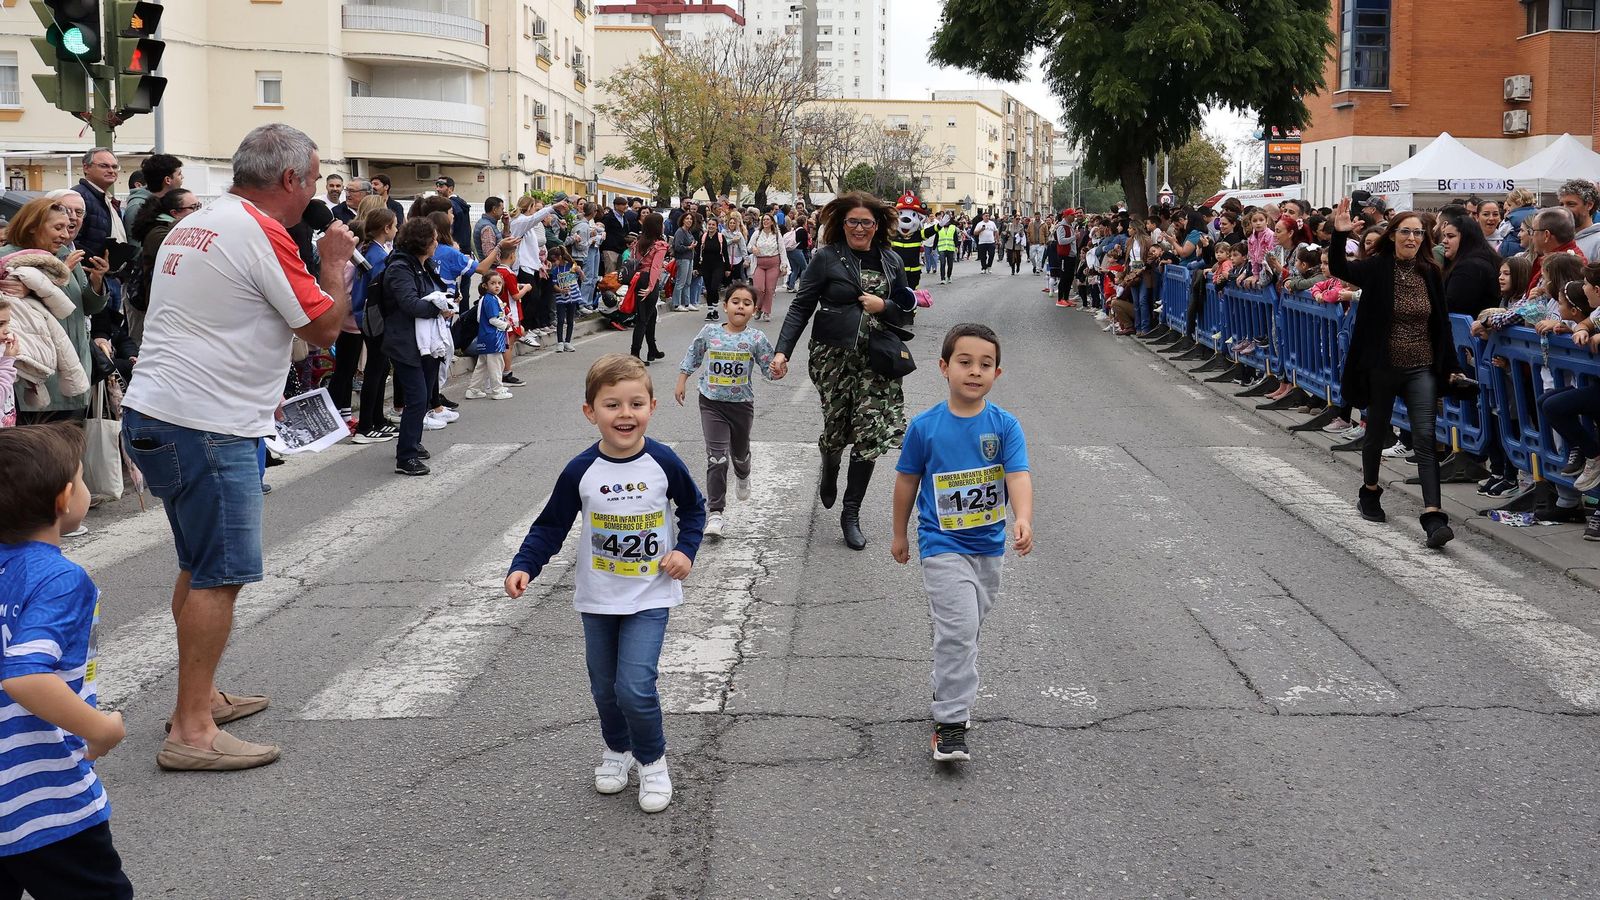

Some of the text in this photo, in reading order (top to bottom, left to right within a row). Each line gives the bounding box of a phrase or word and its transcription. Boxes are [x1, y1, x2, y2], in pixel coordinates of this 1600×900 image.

[1366, 180, 1400, 193] BOMBEROS
[1453, 182, 1502, 190] TIENDA
[713, 362, 744, 376] 086
[938, 473, 961, 482] CARRERA
[961, 470, 983, 479] INFANTIL
[949, 479, 975, 487] BOMBEROS
[950, 485, 998, 511] 125
[594, 513, 618, 522] CARRERA
[619, 515, 643, 523] INFANTIL
[604, 520, 657, 530] BOMBEROS DE JEREZ
[602, 533, 658, 557] 426
